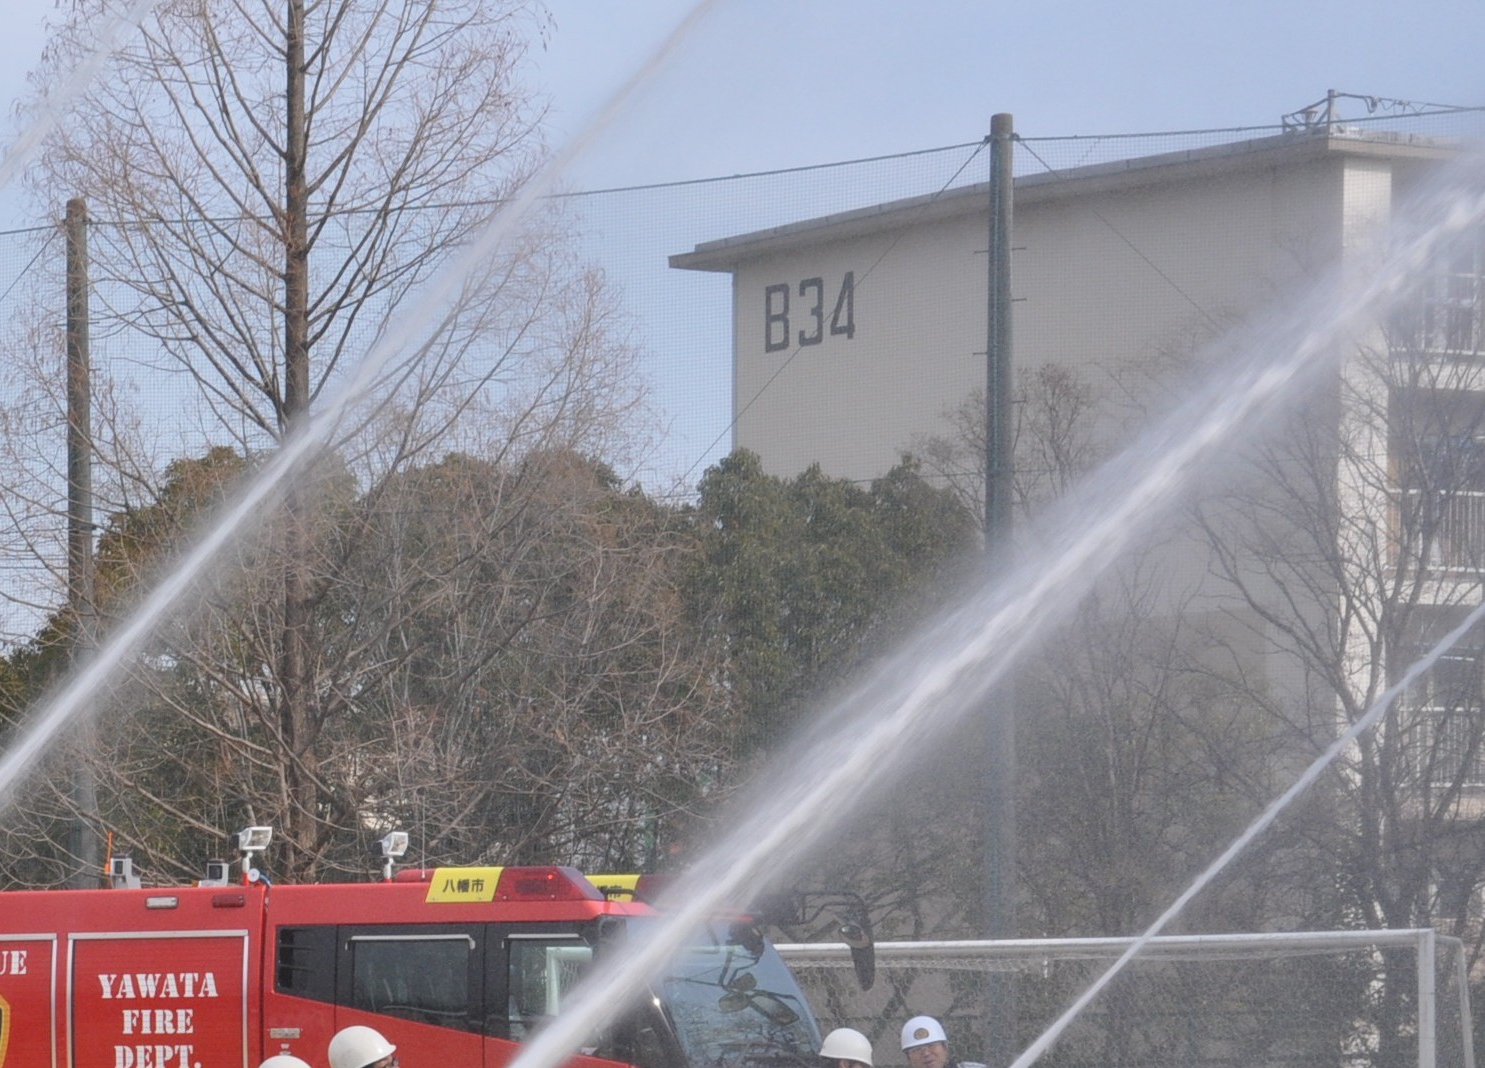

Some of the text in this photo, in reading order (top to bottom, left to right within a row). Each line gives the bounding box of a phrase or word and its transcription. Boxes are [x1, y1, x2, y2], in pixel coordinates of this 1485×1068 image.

[765, 271, 856, 353] B34
[442, 878, 485, 894] 八幡市
[98, 972, 219, 999] YAWATA
[122, 1009, 194, 1034] FIRE
